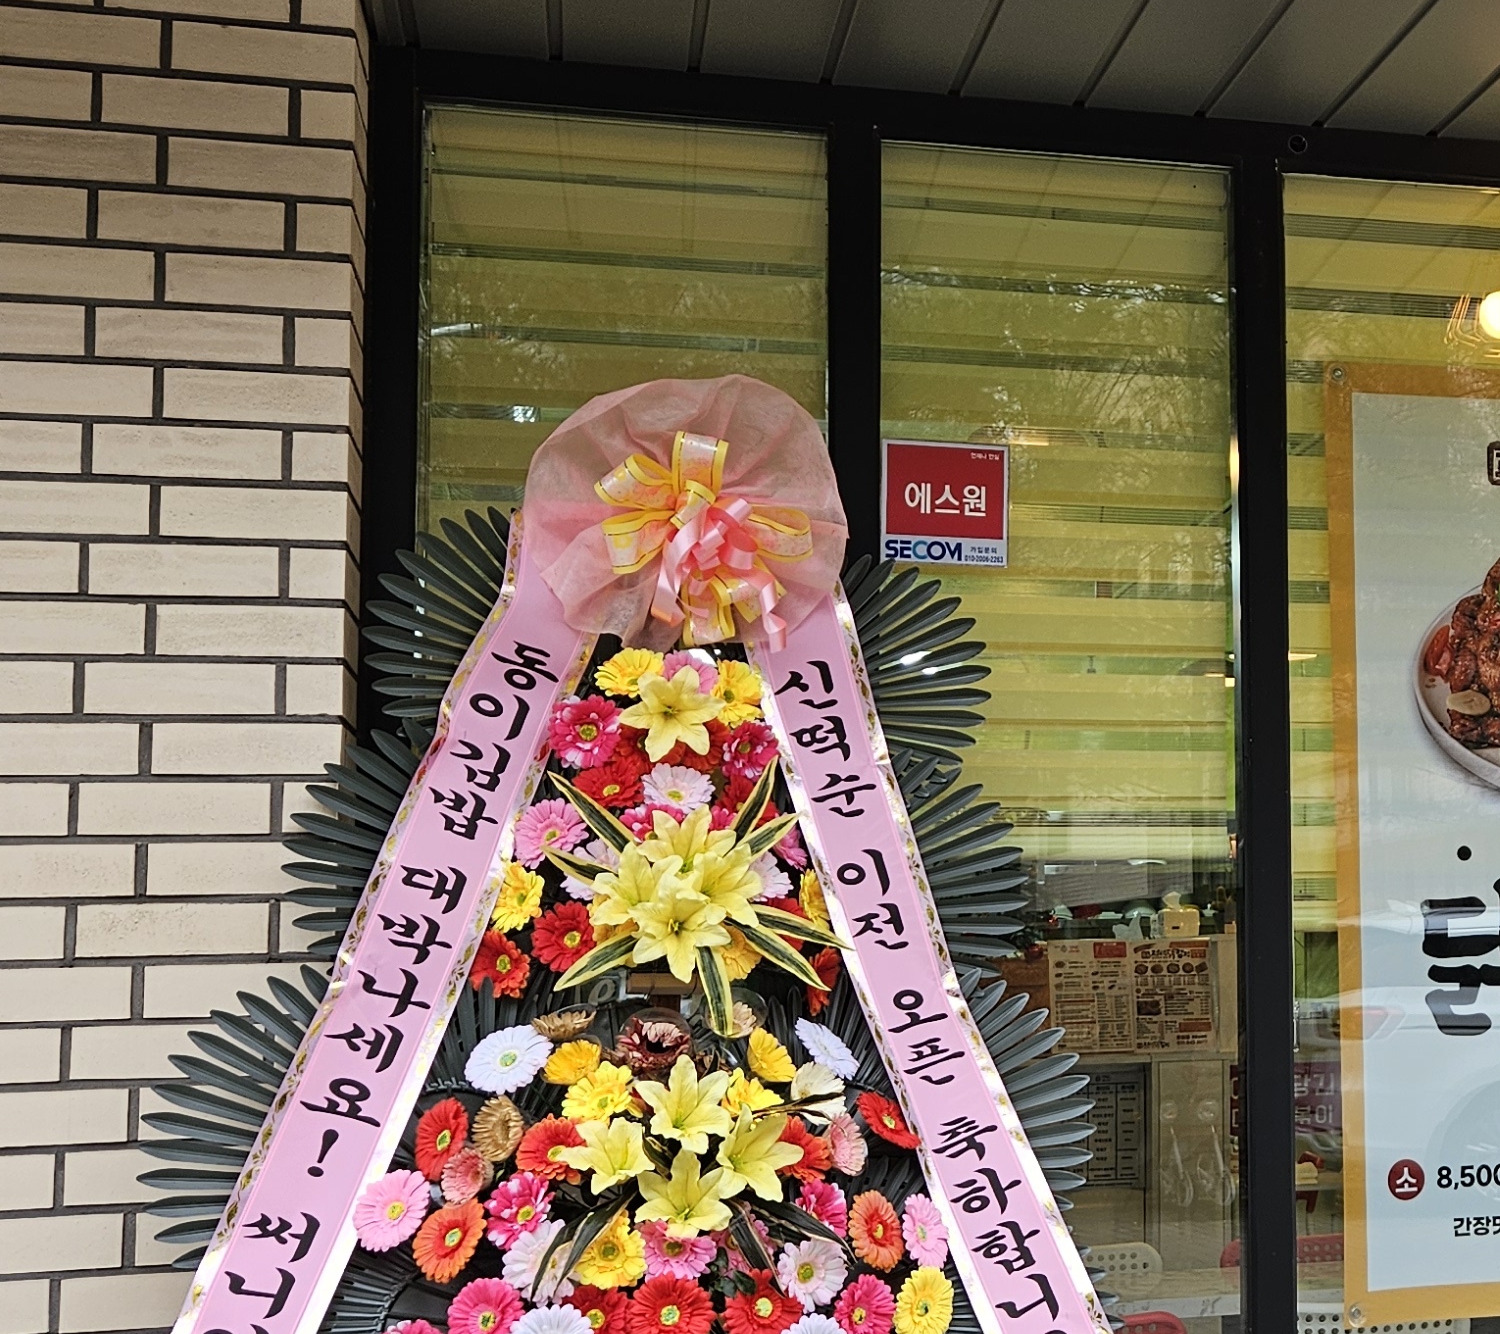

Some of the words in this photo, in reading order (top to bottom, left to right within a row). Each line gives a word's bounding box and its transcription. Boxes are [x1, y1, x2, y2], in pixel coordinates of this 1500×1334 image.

[904, 482, 986, 517] 에스원
[885, 539, 962, 562] SECOM
[428, 641, 559, 841] 동이김밥
[774, 660, 877, 818] 신떡순
[837, 849, 909, 950] 이전
[301, 865, 467, 1178] 대박나세요!
[888, 989, 965, 1085] 오픈
[1394, 1166, 1418, 1194] 소
